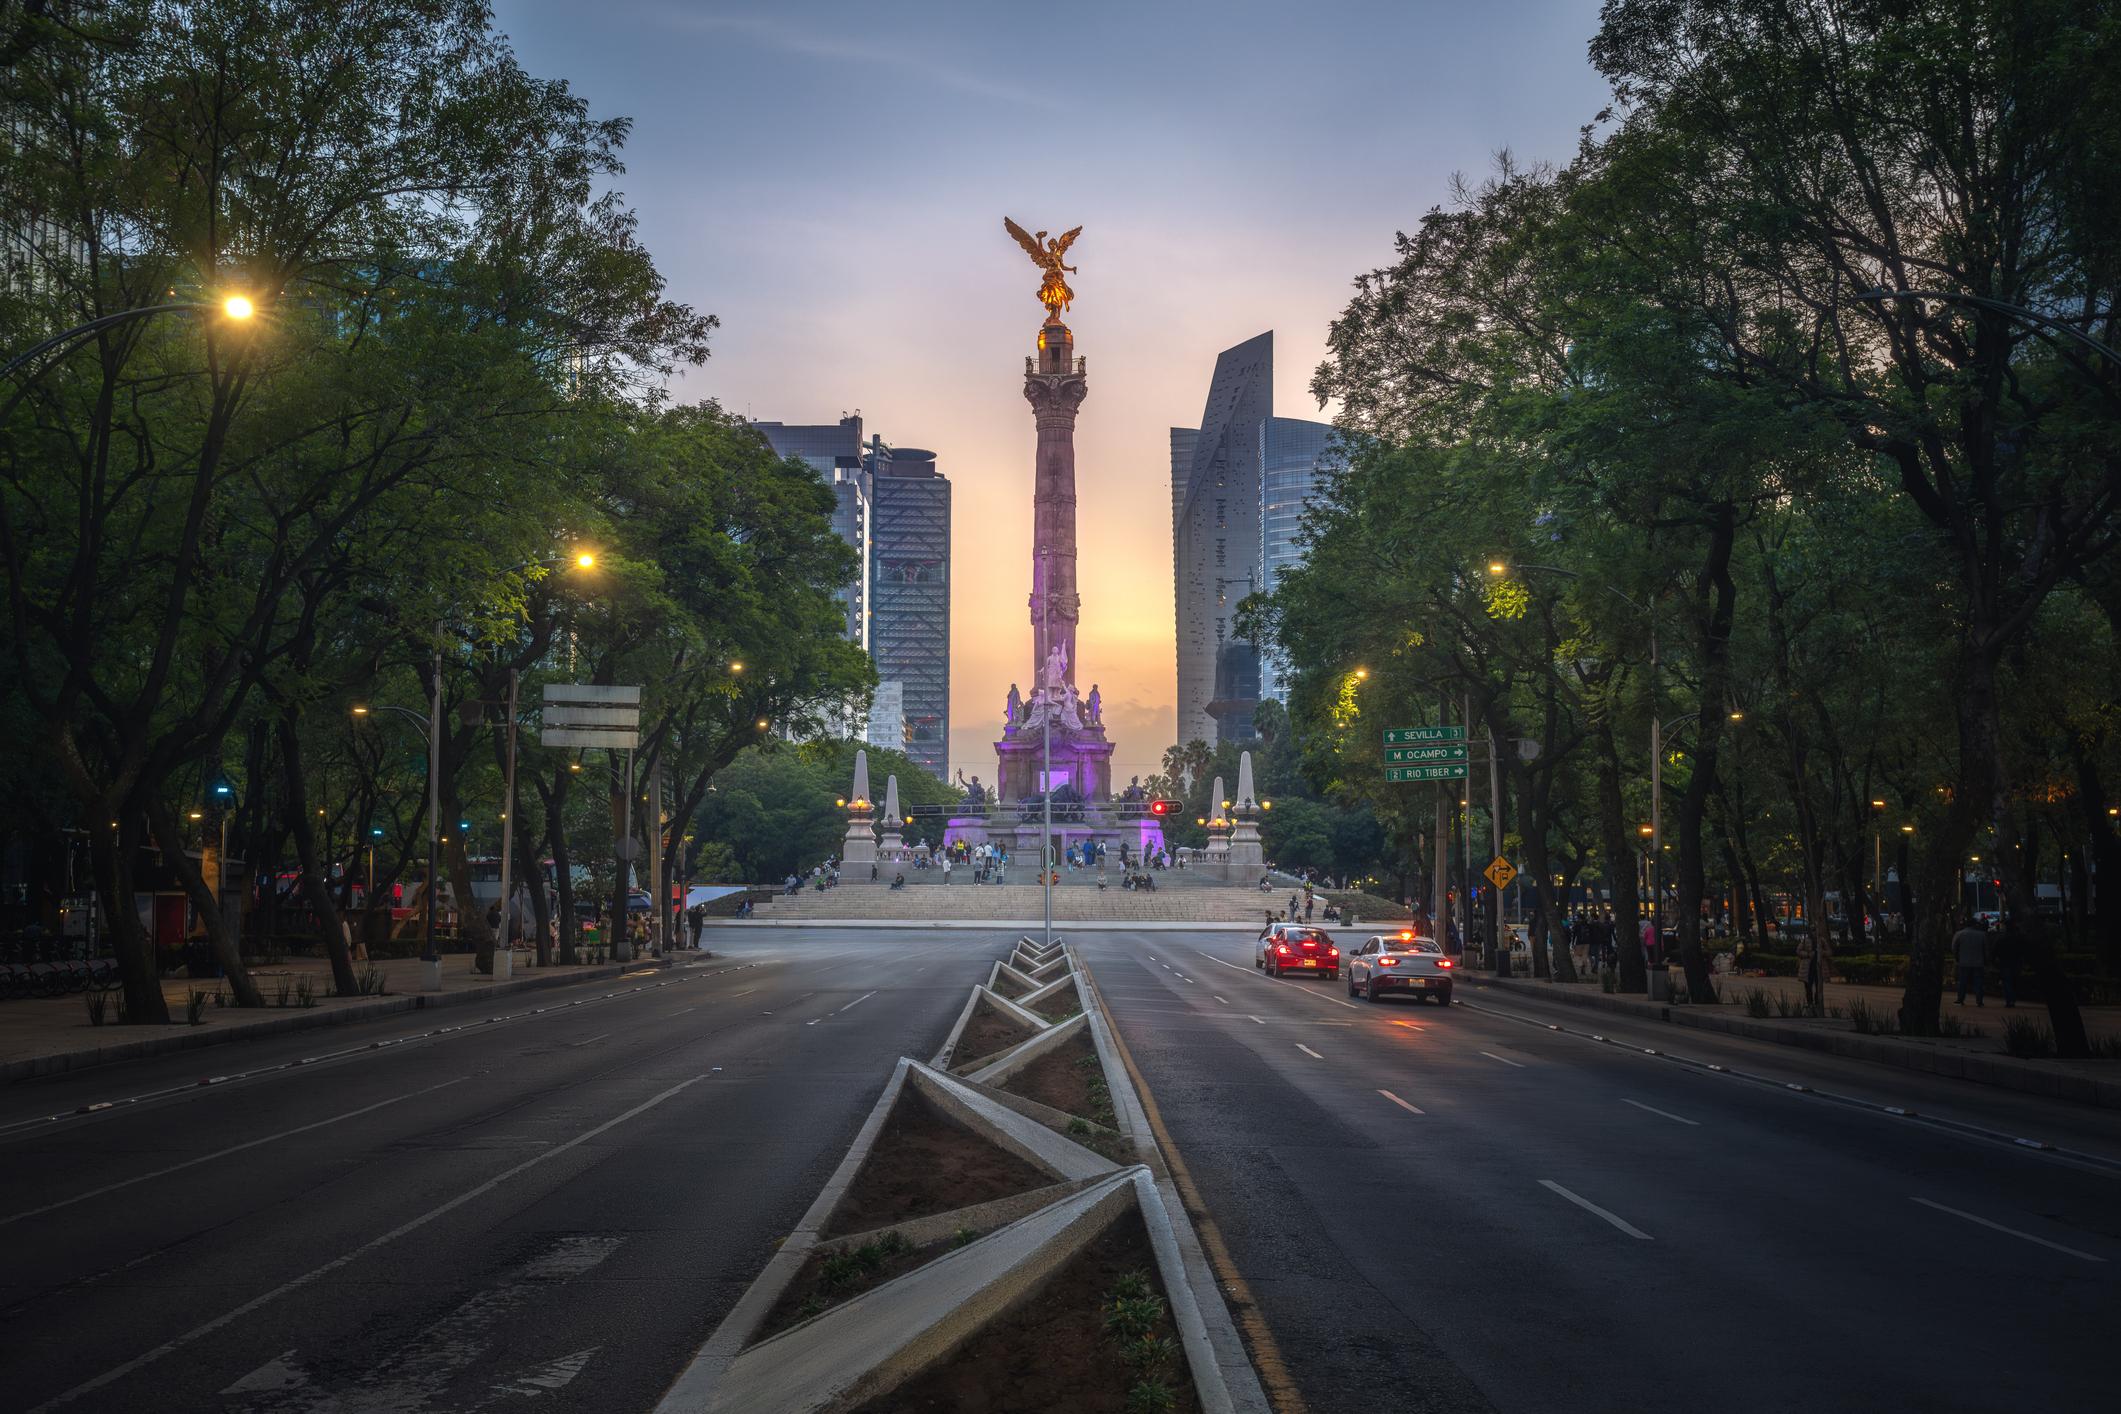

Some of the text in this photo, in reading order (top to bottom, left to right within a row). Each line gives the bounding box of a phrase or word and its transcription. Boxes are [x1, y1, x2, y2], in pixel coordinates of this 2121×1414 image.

[1404, 730, 1443, 740] SEVILLA
[1393, 749, 1448, 760] M OCAMPO
[1406, 769, 1421, 778] RIO
[1425, 767, 1449, 777] TIBER
